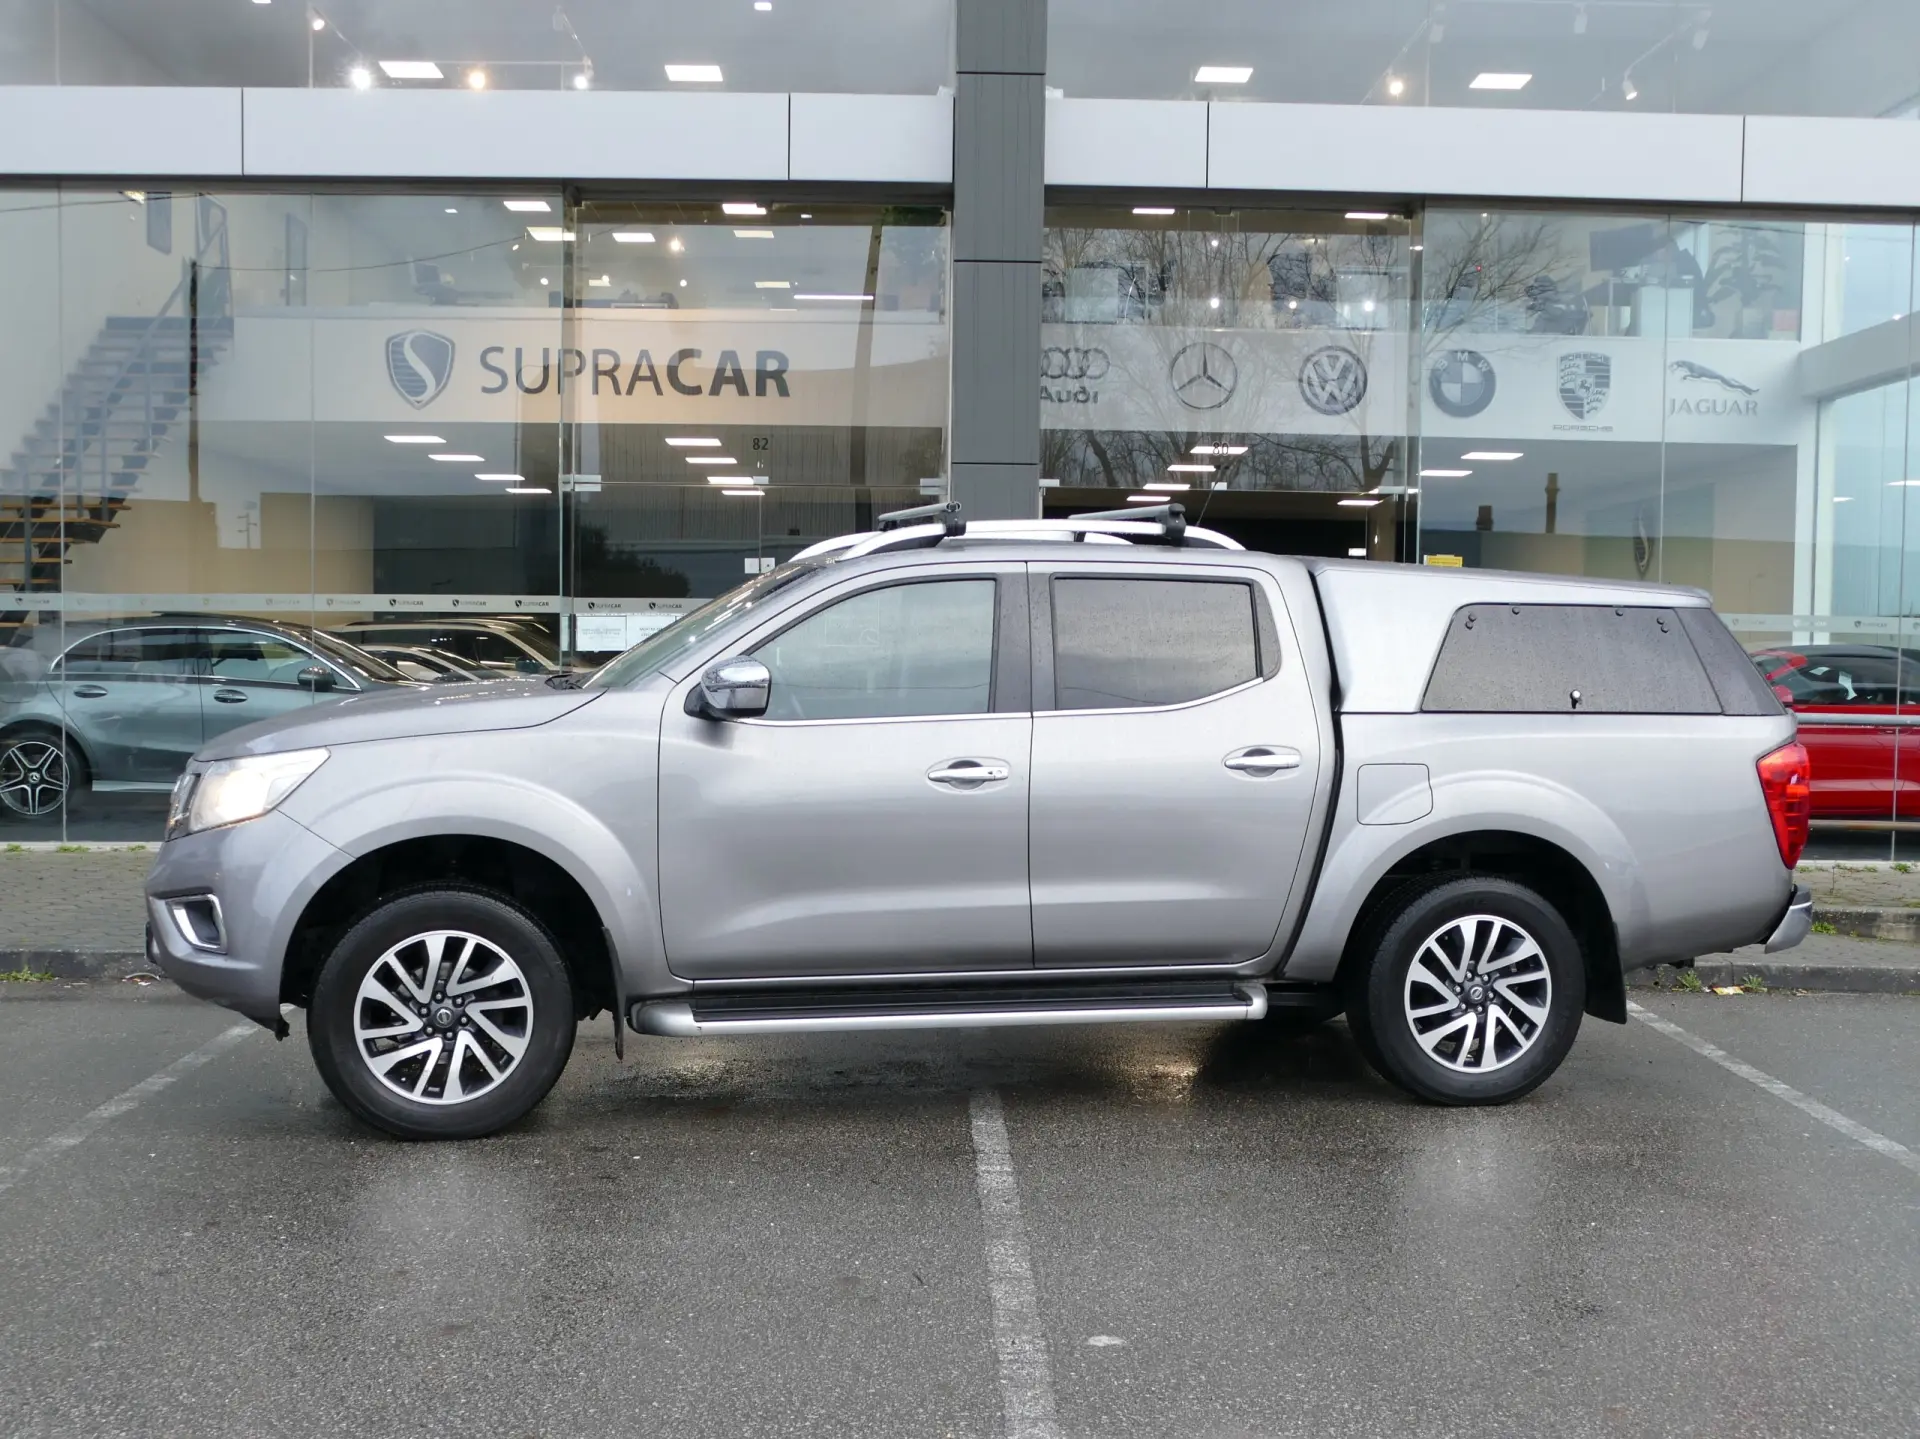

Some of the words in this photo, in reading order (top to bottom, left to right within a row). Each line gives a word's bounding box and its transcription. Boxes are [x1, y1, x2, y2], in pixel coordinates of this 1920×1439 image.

[479, 345, 791, 397] SUPRACAR
[1667, 397, 1758, 419] JAGUAR
[1552, 424, 1614, 432] PORSCHE
[752, 437, 769, 451] 82
[1212, 441, 1229, 456] 80
